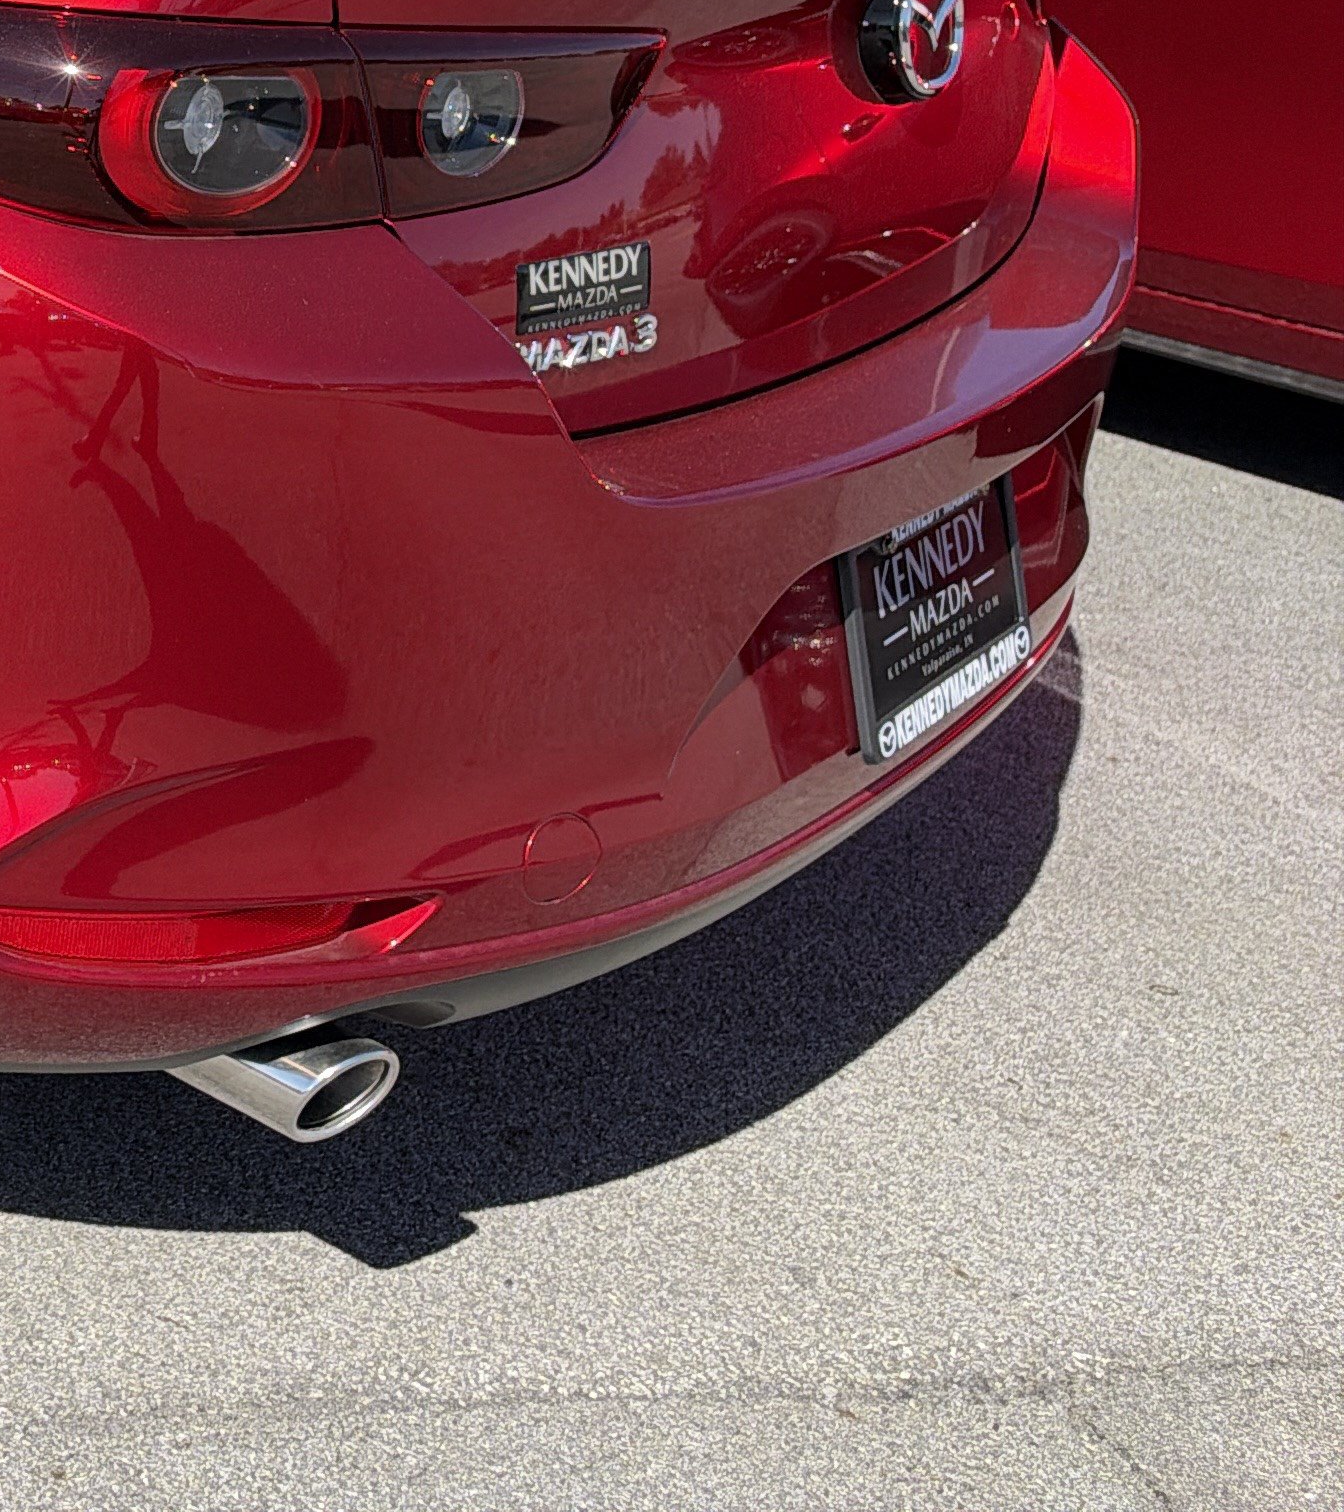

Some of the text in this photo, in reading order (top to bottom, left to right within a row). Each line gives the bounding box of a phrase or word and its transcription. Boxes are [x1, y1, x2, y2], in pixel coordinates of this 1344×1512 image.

[528, 243, 642, 296] KENNEDY
[557, 284, 618, 310] MAZDA
[873, 500, 985, 619] KENNEDY
[909, 576, 974, 641] MAZDA
[894, 631, 1018, 749] KENNEDYMAZDA.COM
